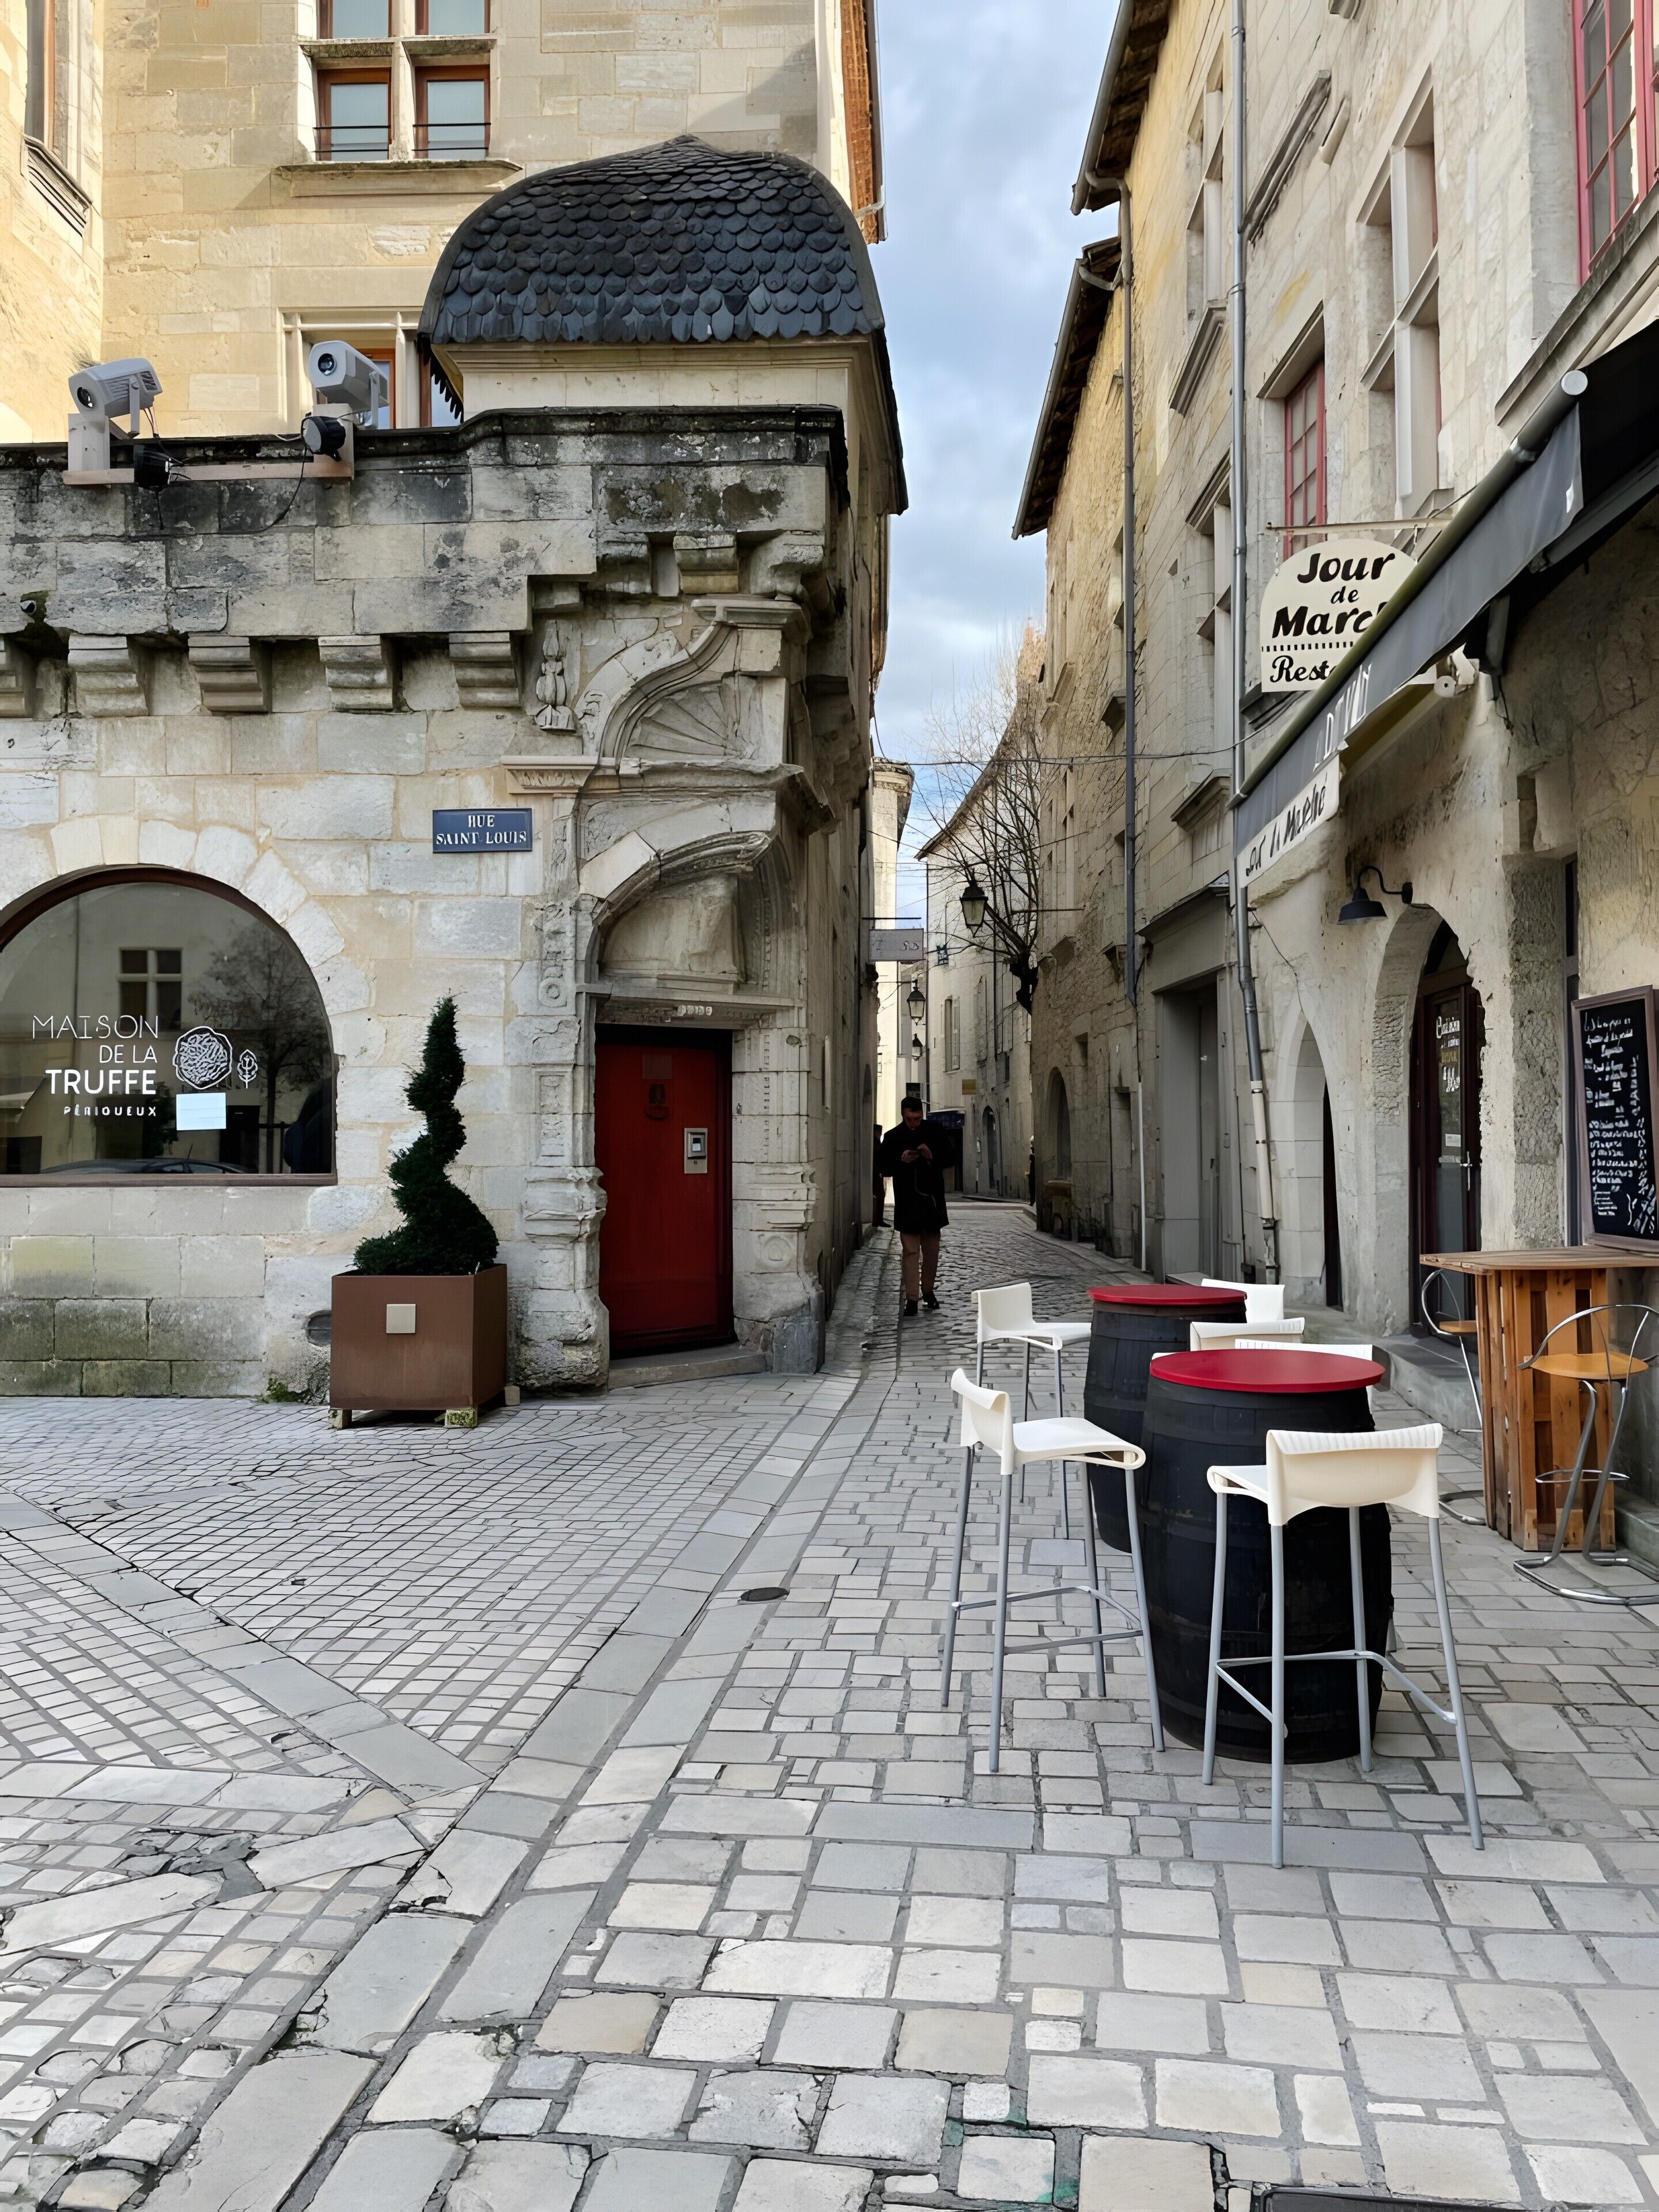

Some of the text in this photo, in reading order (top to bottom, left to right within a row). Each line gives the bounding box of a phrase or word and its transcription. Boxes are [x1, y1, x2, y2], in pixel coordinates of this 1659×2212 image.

[1297, 552, 1396, 584] Jour
[1330, 585, 1359, 604] de
[1271, 601, 1387, 638] Marc
[468, 815, 495, 828] RUE
[435, 831, 527, 845] SAINT LOUIS
[32, 1015, 158, 1039] MAISON
[99, 1044, 158, 1063] DE LA
[45, 1069, 156, 1094] TRUFFE
